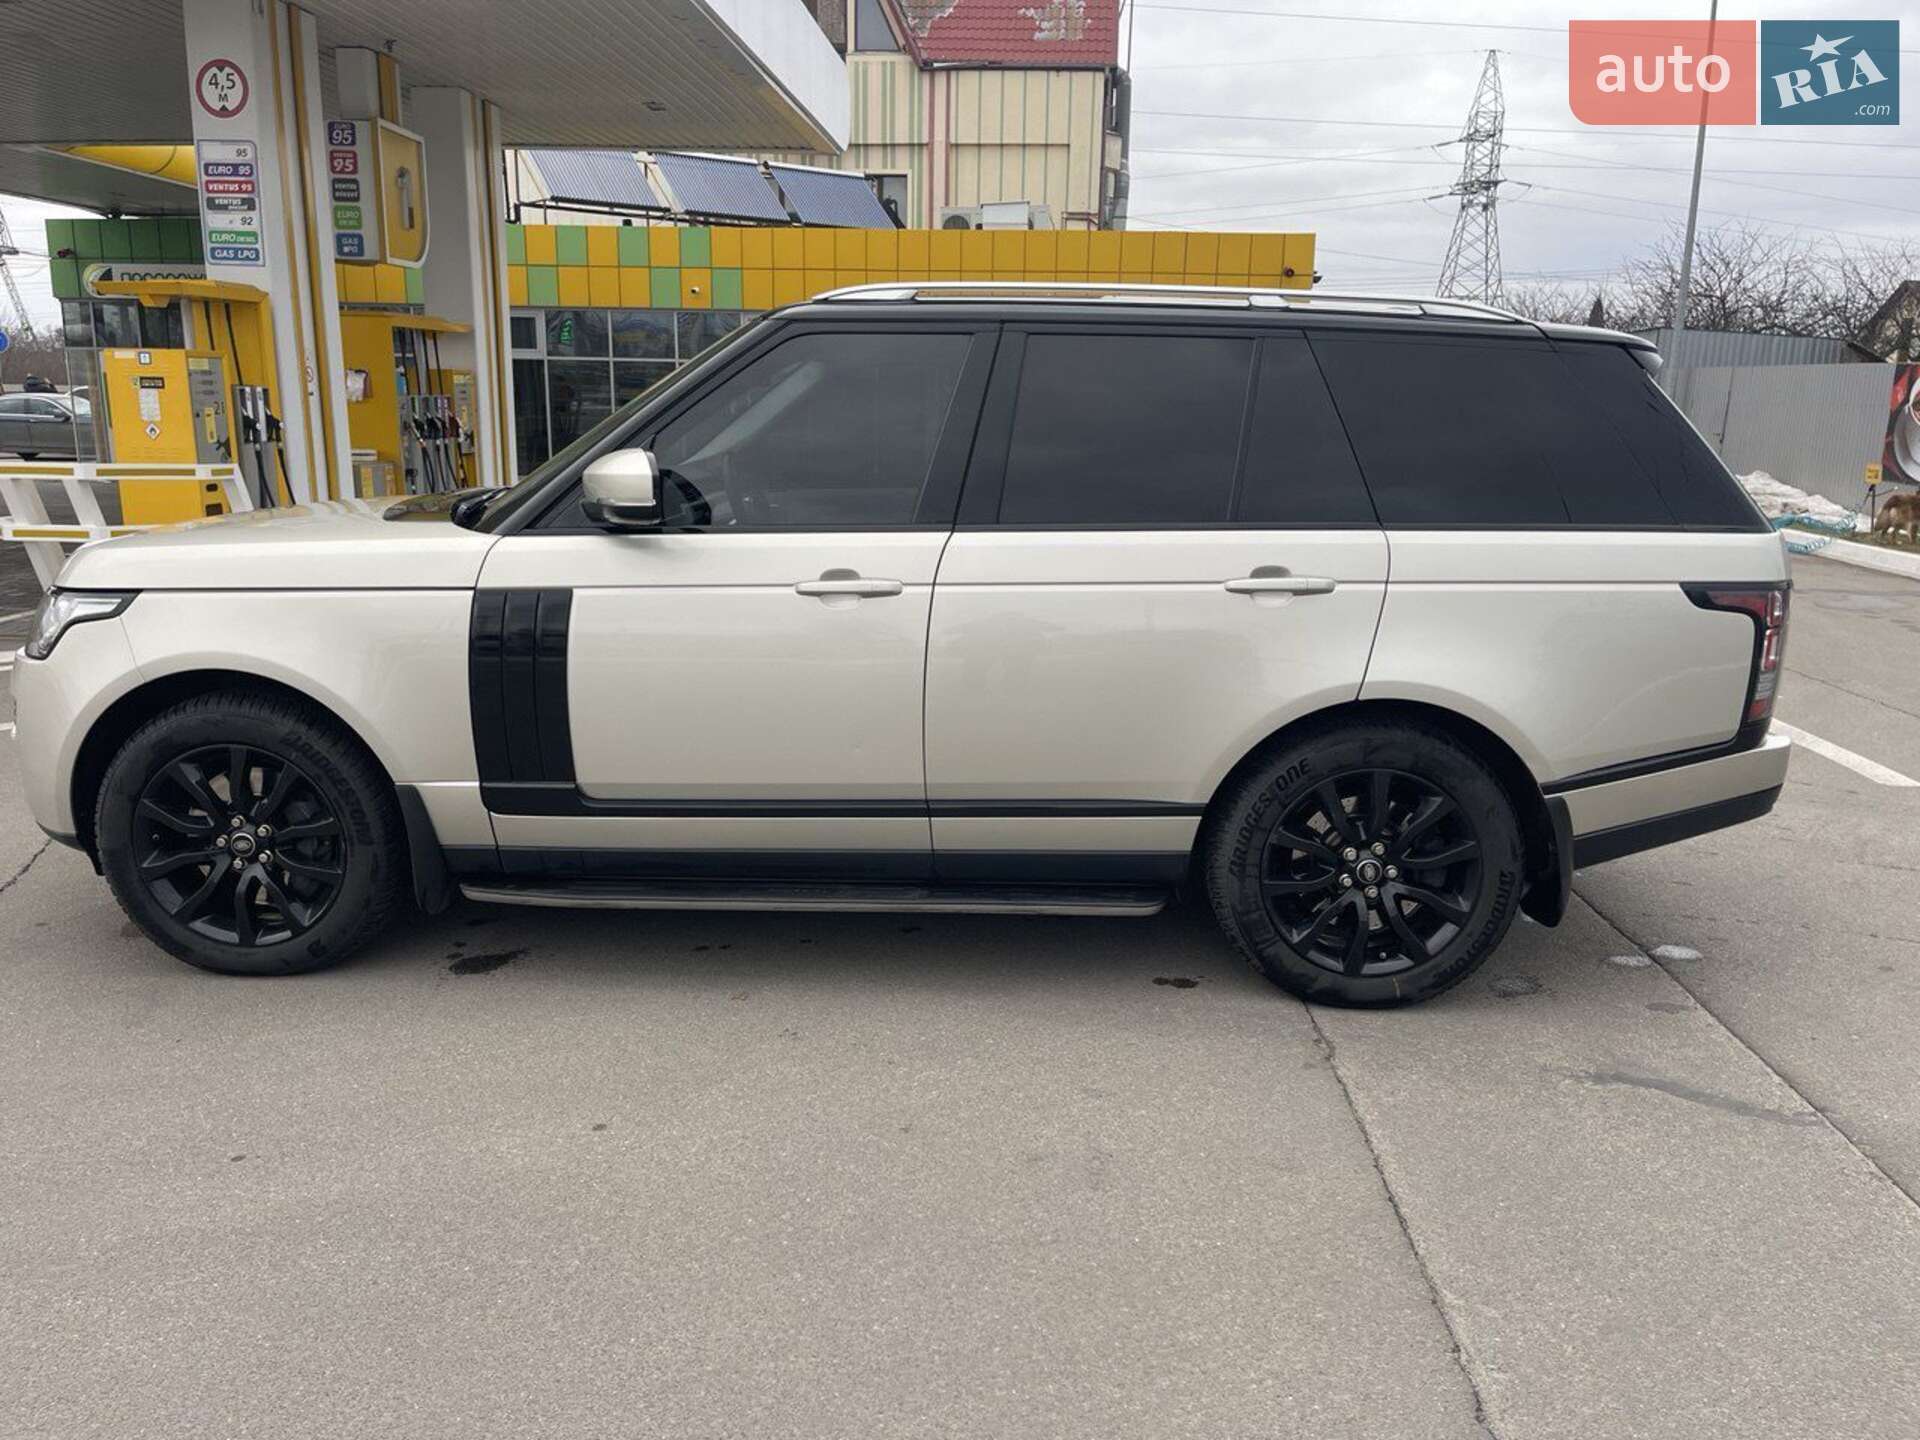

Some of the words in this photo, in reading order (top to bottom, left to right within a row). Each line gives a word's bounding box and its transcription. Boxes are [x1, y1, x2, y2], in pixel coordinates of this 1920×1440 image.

[208, 72, 236, 92] 4,5
[332, 129, 353, 145] 95
[235, 148, 249, 158] 95
[334, 158, 354, 172] 95
[207, 165, 233, 175] EURO
[238, 165, 252, 176] 95
[208, 183, 240, 192] VENTUS
[240, 183, 253, 192] 95
[240, 216, 254, 225] 92
[211, 232, 236, 242] EURO
[214, 249, 235, 259] GAS
[238, 250, 256, 259] LPG
[1228, 756, 1312, 877] BRIDGESONE
